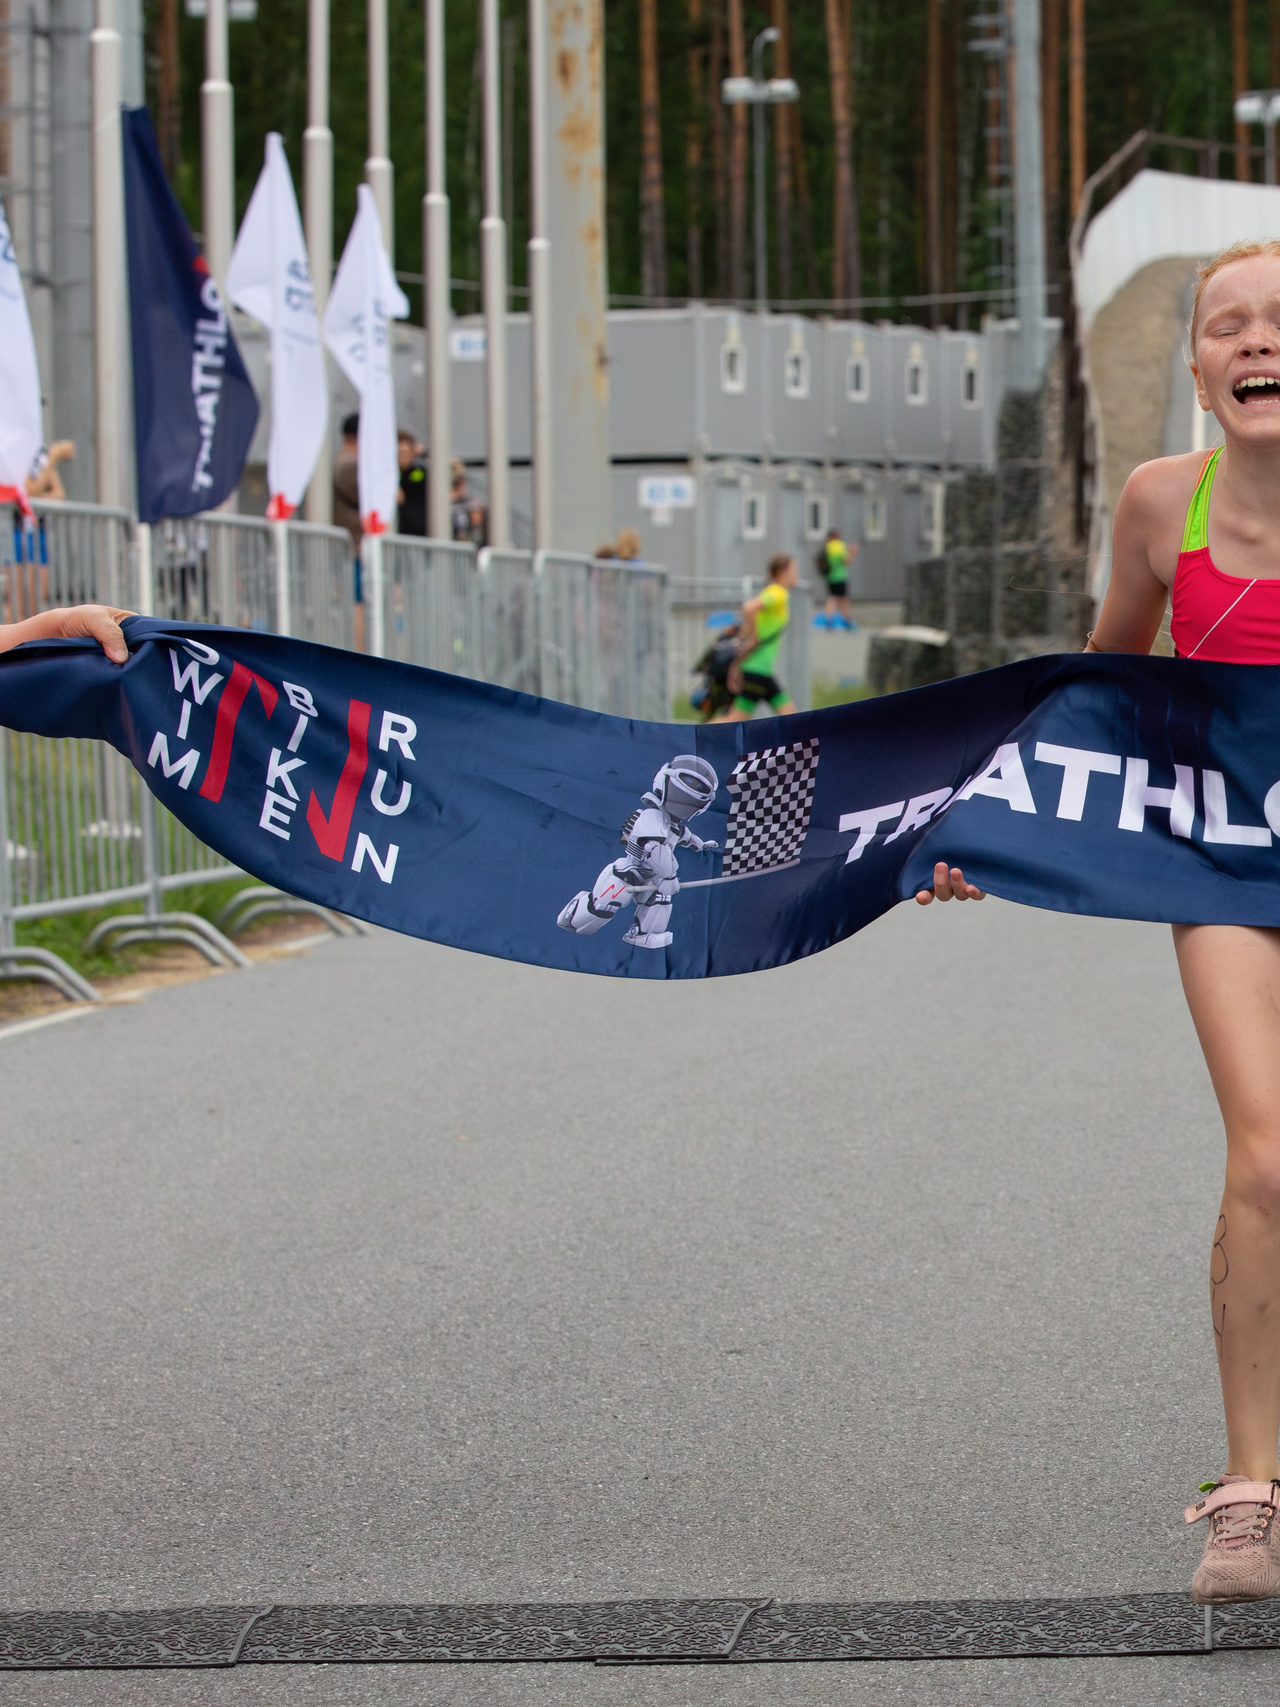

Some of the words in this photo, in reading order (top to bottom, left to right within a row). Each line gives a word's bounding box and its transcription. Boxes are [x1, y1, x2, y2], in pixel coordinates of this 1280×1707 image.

[191, 255, 228, 493] TATHLO
[259, 680, 318, 841] BIKE
[351, 710, 417, 884] RUN
